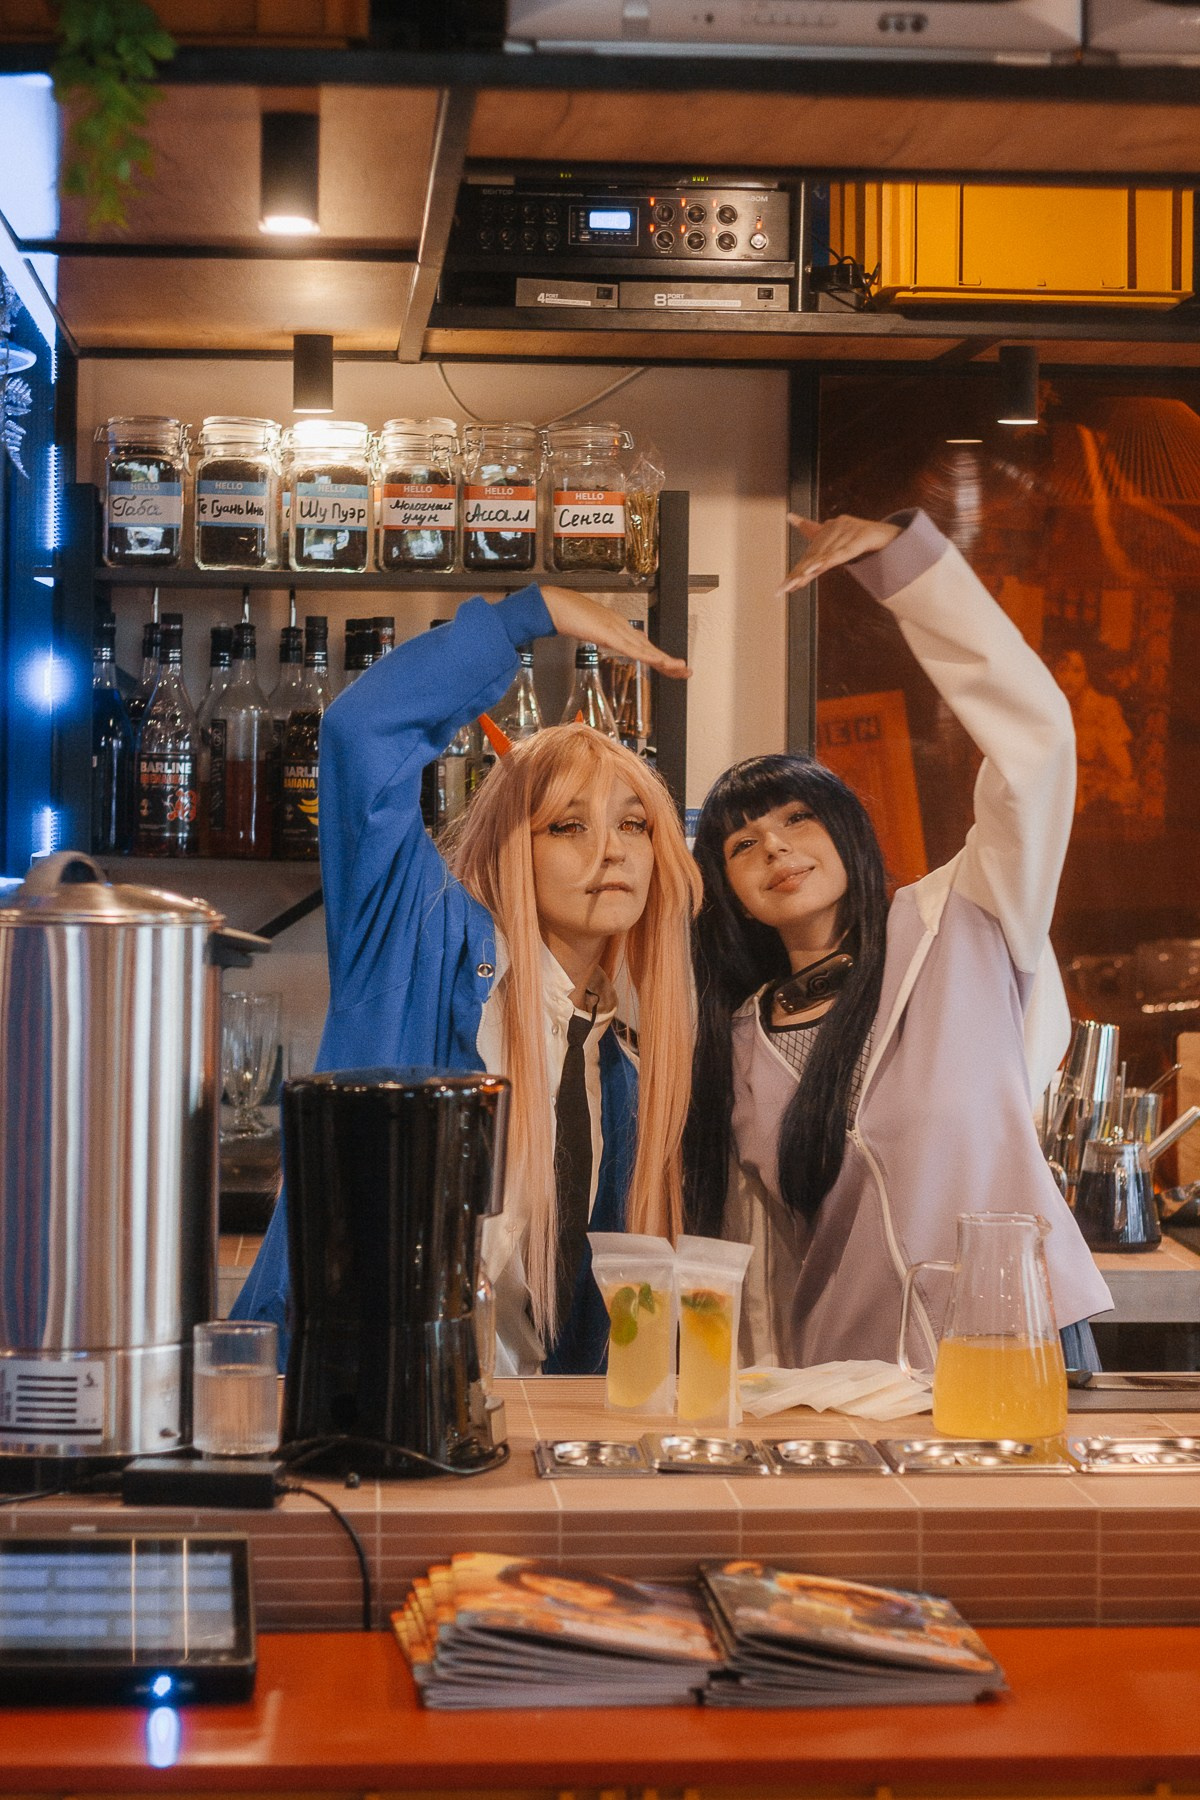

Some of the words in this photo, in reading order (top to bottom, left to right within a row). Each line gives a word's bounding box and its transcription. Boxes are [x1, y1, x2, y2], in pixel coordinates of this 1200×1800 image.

[537, 292, 546, 304] 4
[654, 293, 667, 307] 8
[131, 483, 160, 491] HELLO
[215, 481, 244, 490] HELLO
[318, 484, 347, 493] HELLO
[403, 485, 433, 493] HELLO
[484, 487, 514, 495] HELLO
[575, 492, 604, 500] HELLO
[211, 499, 244, 518] Гуань
[300, 499, 328, 524] Шу
[331, 502, 366, 524] Пуэр
[465, 502, 530, 523] Ассам
[558, 508, 615, 528] Сенча
[140, 761, 192, 774] BARLINE
